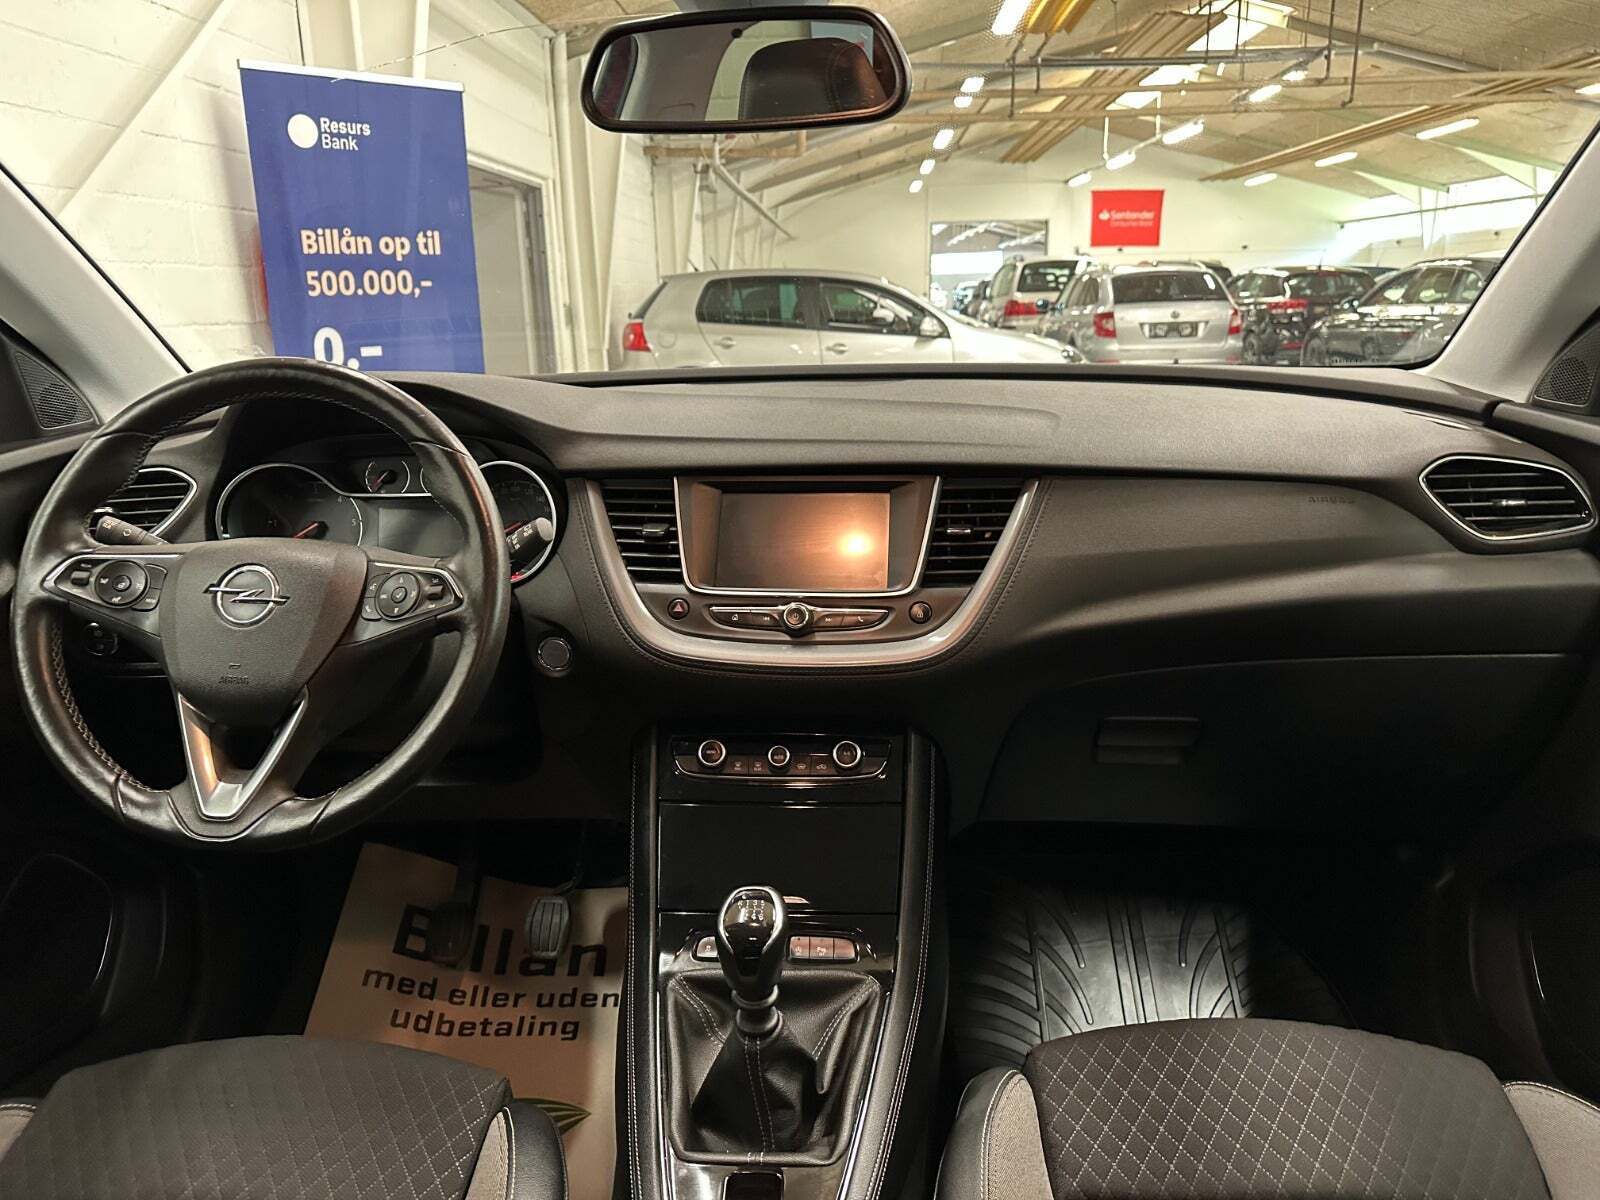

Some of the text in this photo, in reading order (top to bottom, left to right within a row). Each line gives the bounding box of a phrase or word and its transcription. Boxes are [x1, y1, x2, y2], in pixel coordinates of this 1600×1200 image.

[320, 117, 371, 136] Resurs
[321, 134, 359, 151] Bank
[300, 227, 441, 260] Billån op til
[306, 270, 433, 297] 500.000,-
[392, 904, 608, 977] Blln
[361, 968, 620, 1009] med eller uden
[389, 1007, 581, 1041] udbetaling
